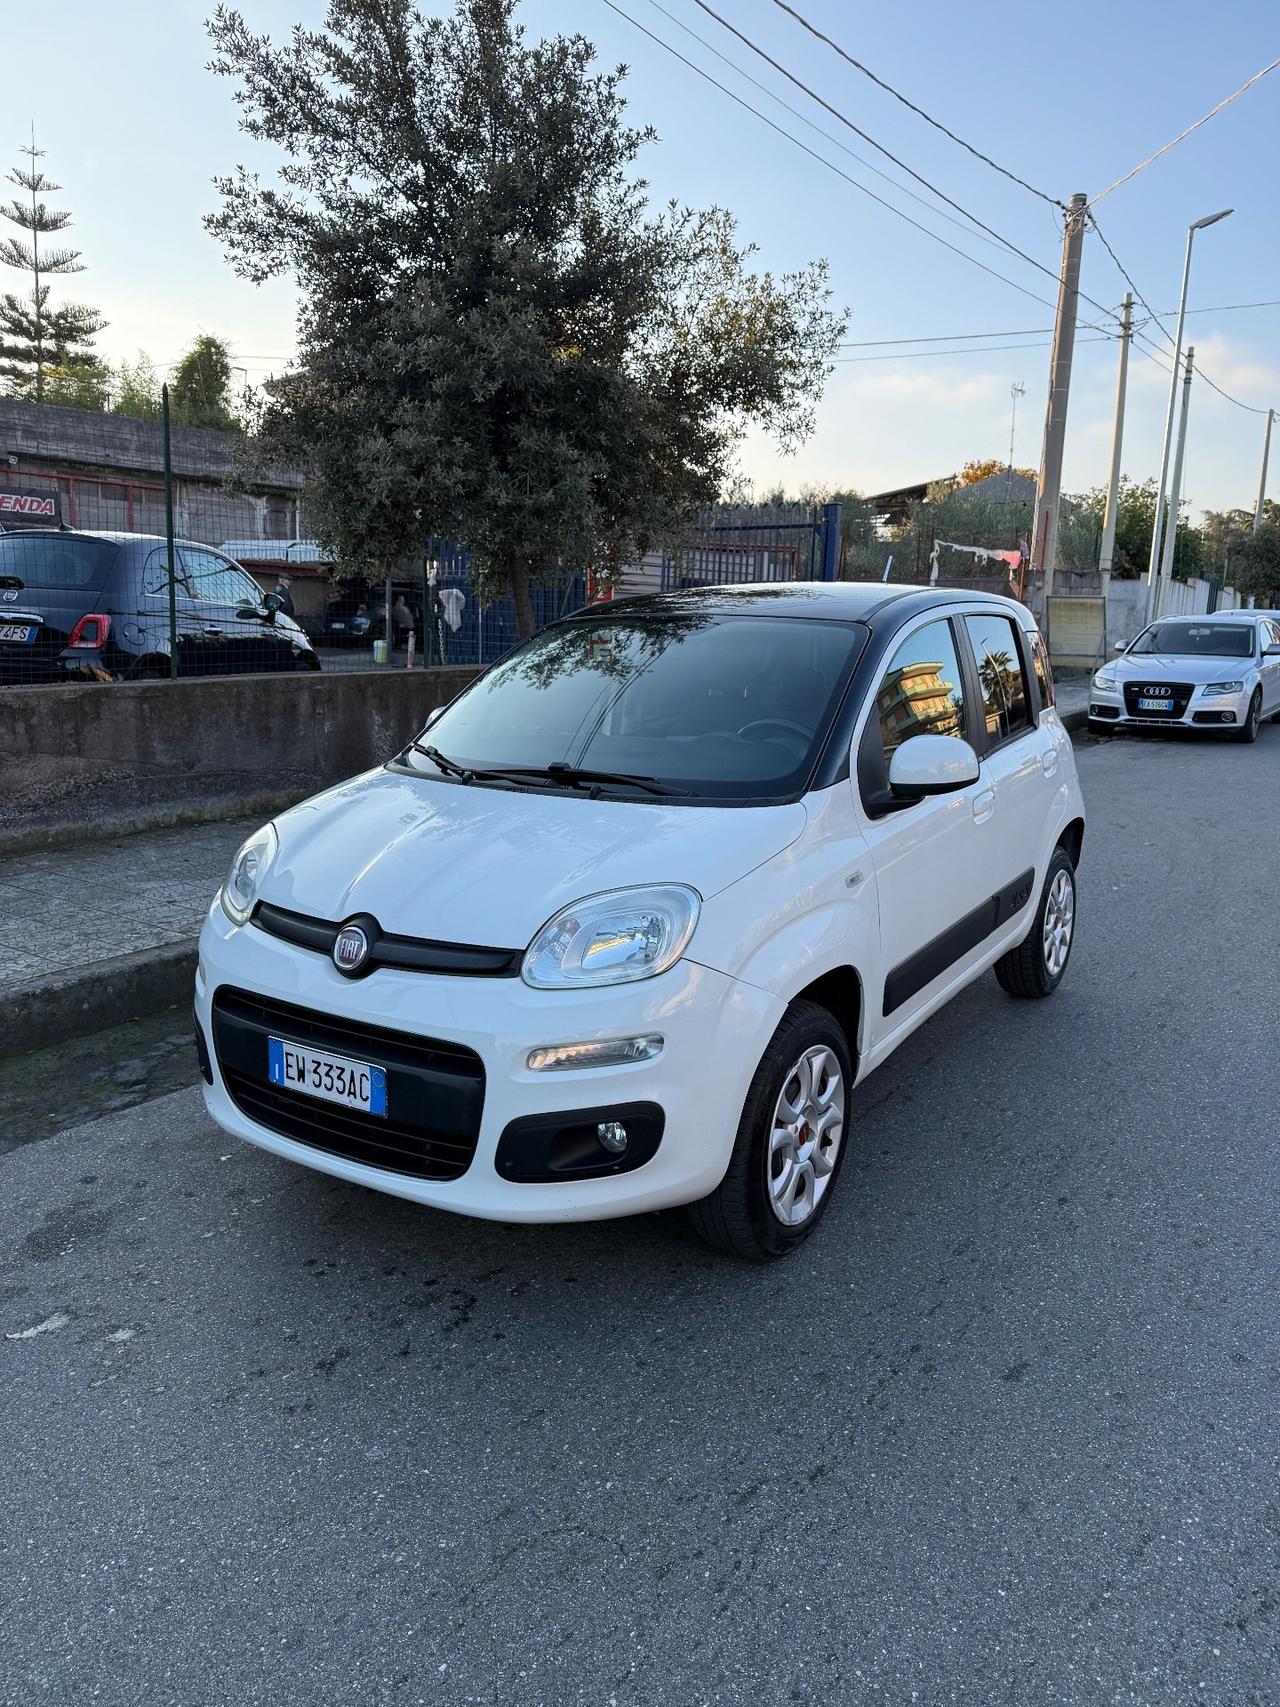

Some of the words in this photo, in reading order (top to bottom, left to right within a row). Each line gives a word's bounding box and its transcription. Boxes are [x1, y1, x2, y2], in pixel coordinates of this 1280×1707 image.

[340, 938, 361, 960] FIAT
[285, 1051, 306, 1084] EW
[312, 1059, 370, 1102] 333AC
